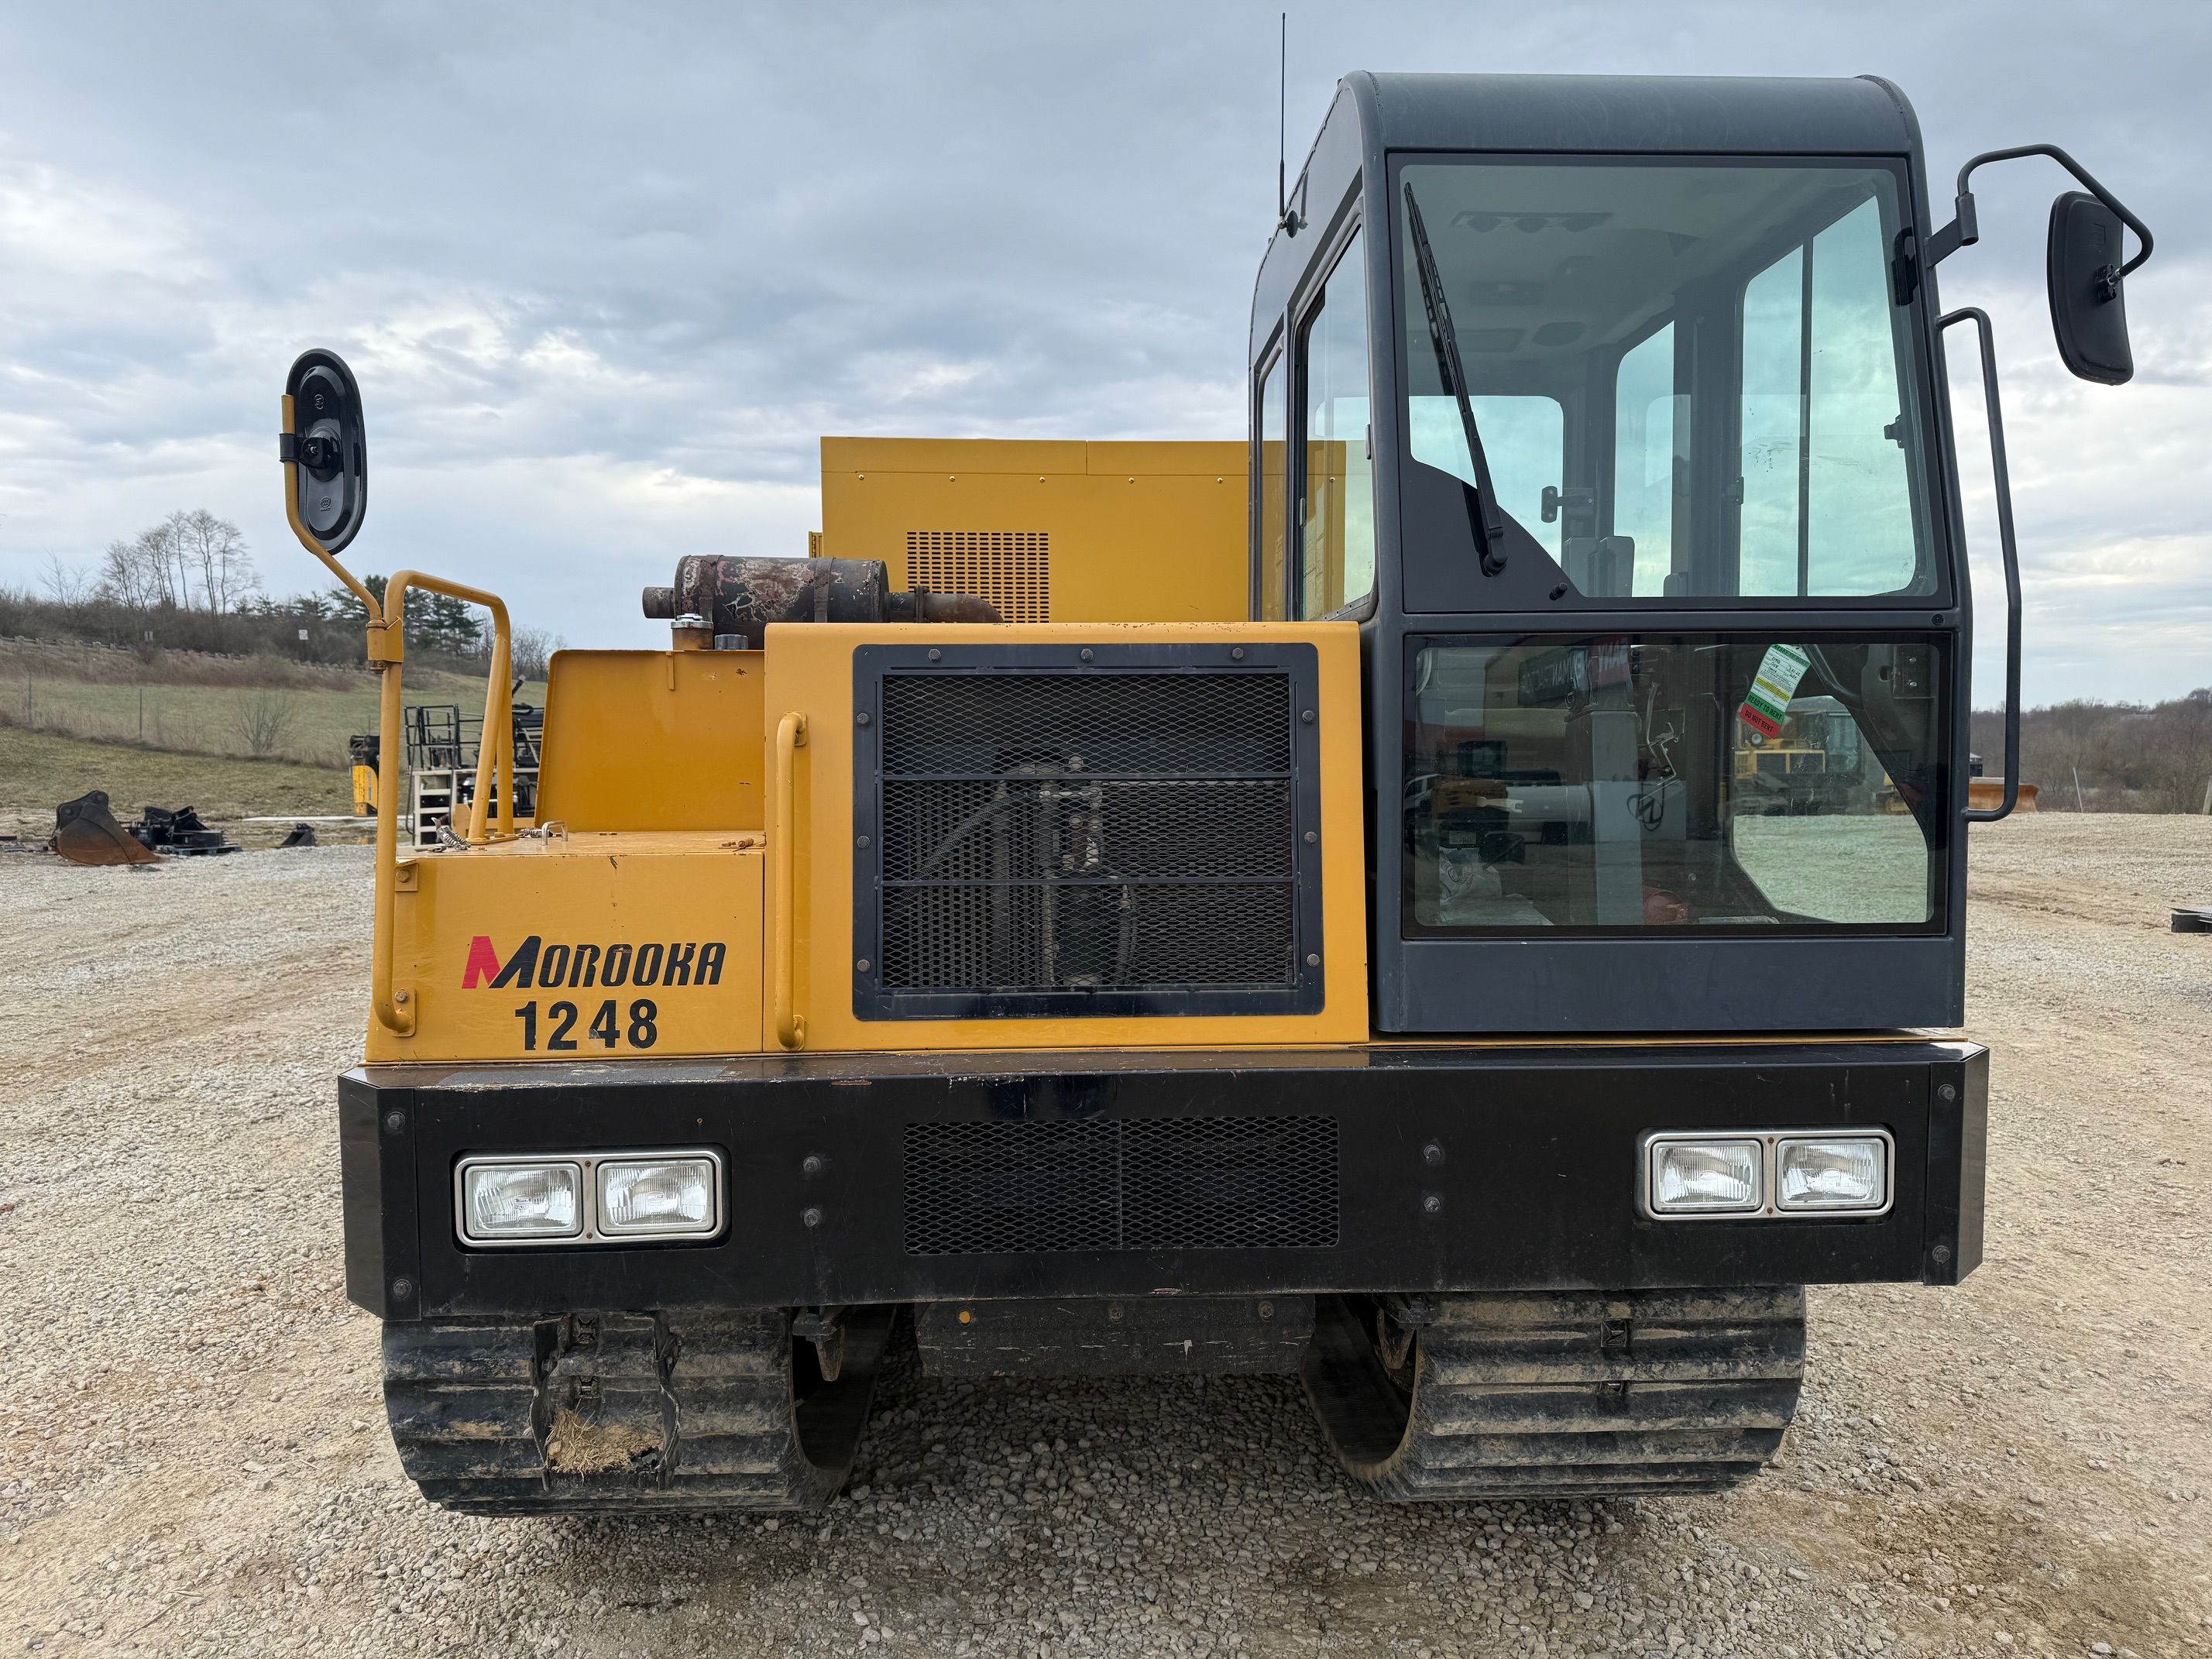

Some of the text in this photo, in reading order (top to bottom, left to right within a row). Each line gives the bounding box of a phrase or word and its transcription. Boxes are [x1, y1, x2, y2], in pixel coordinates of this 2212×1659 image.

[1745, 709, 1752, 718] DO
[1751, 713, 1762, 724] NOT
[1748, 695, 1763, 708] READY
[1769, 708, 1782, 720] RENT
[462, 936, 726, 989] MOROOKA
[515, 998, 658, 1051] 1248
